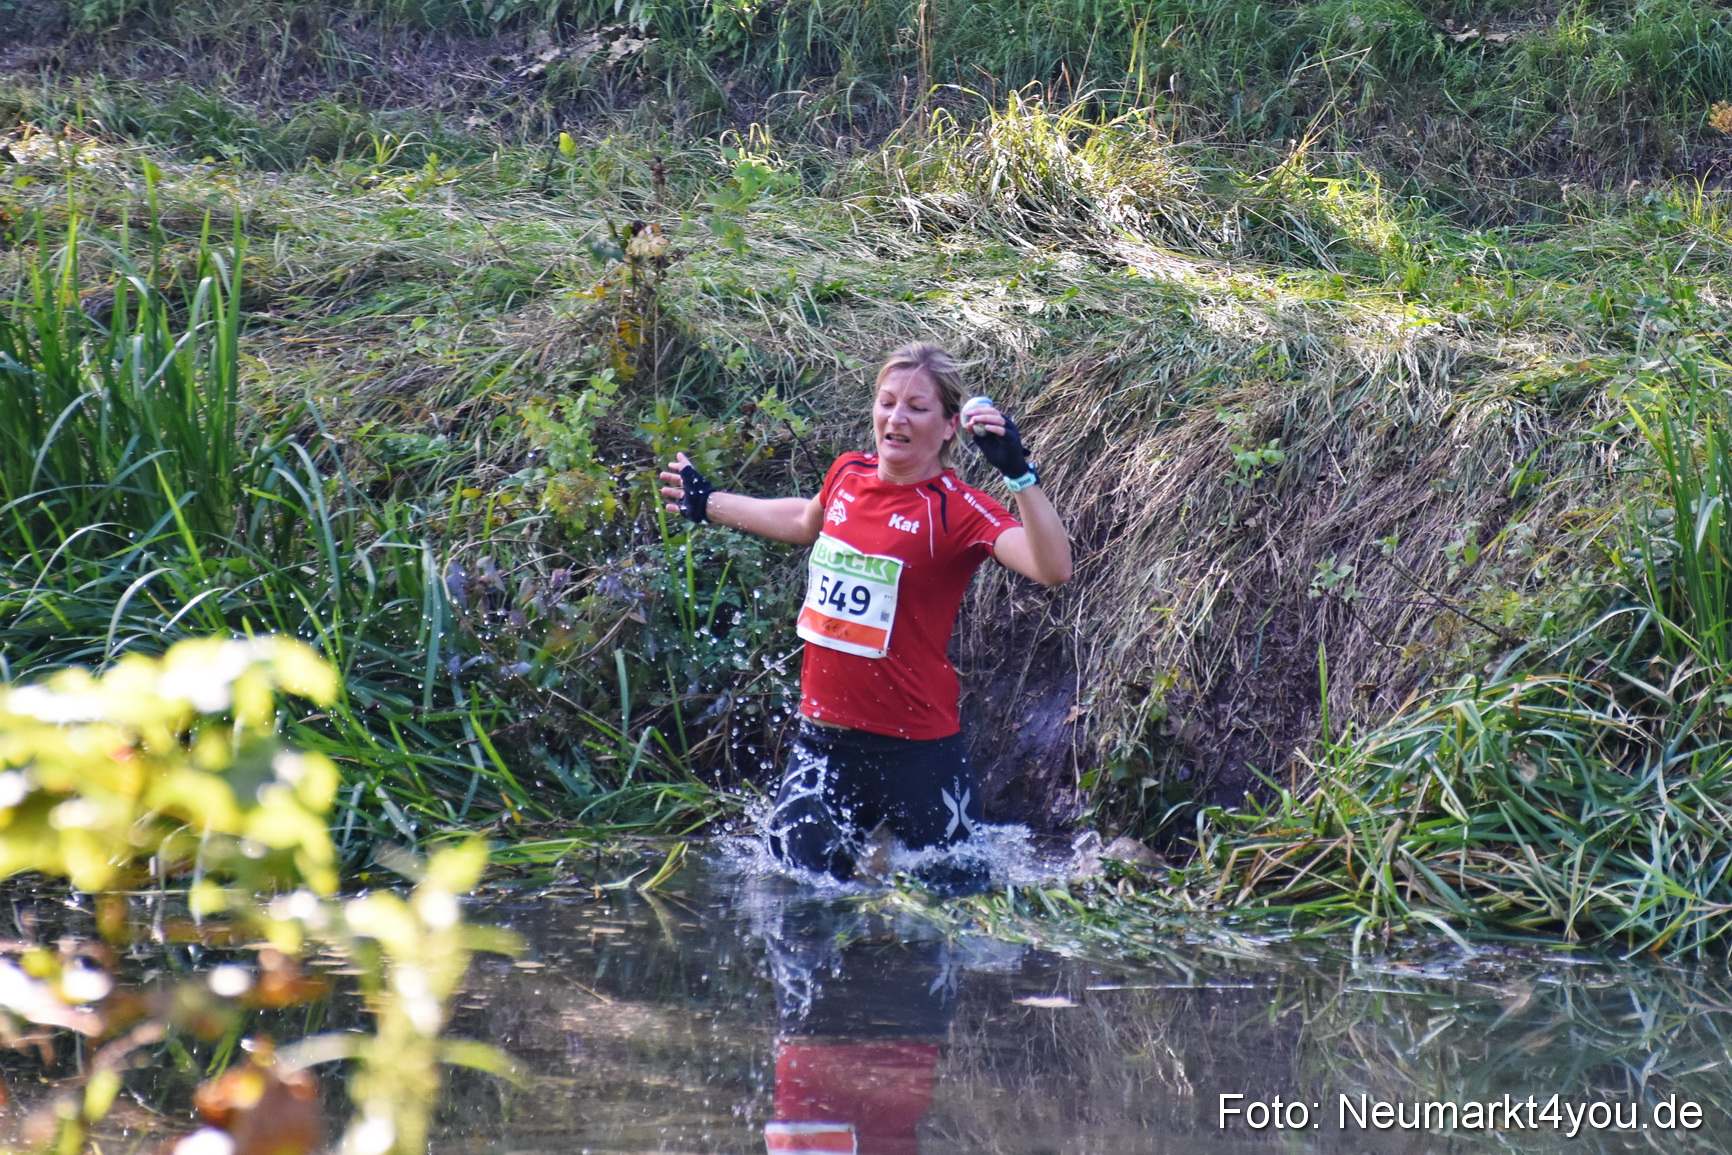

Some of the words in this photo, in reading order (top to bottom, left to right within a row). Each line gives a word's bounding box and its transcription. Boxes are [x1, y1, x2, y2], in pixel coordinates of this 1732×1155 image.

[888, 513, 920, 534] Kat
[816, 542, 889, 581] BOCK
[818, 575, 871, 616] 549
